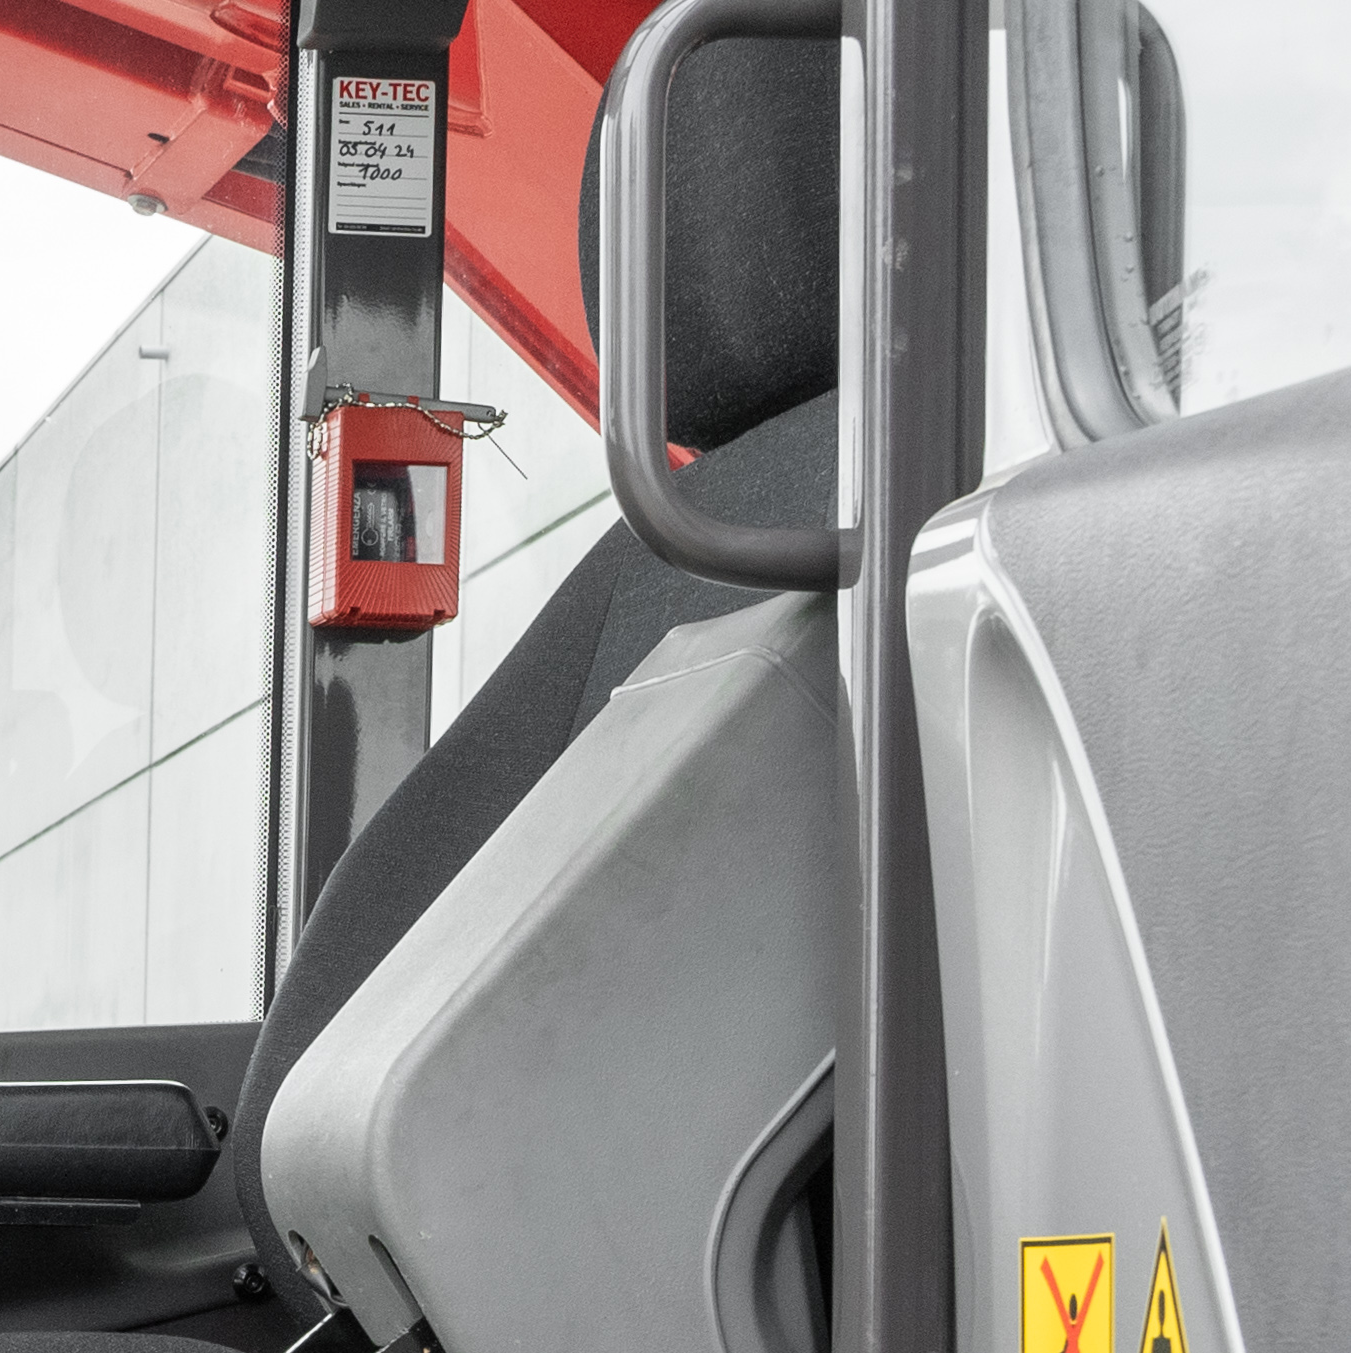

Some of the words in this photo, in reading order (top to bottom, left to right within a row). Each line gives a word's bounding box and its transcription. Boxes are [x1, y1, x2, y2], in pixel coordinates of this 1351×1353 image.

[339, 80, 430, 102] KEY-TEC
[339, 101, 361, 109] SALES
[367, 102, 394, 110] RENTAL
[362, 120, 396, 136] 511
[394, 144, 414, 158] 24
[352, 491, 361, 556] EMERGENZA
